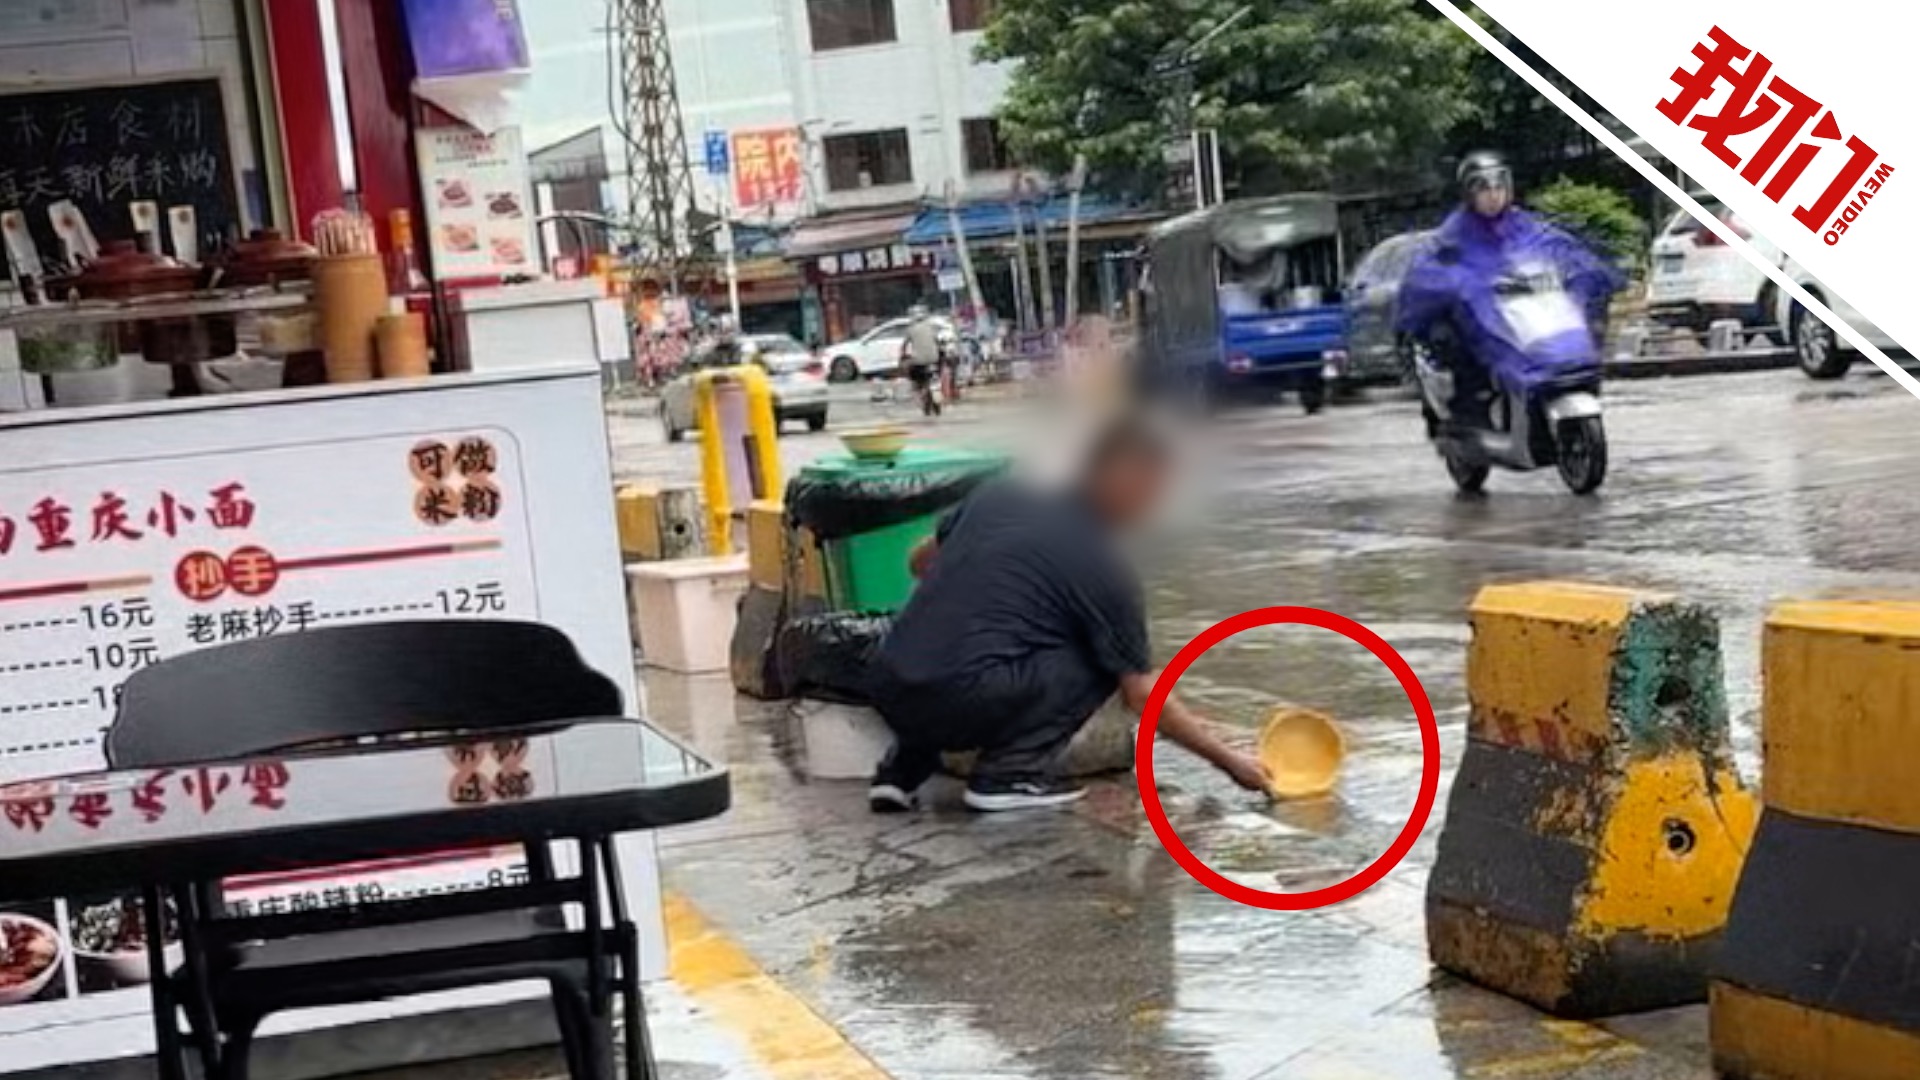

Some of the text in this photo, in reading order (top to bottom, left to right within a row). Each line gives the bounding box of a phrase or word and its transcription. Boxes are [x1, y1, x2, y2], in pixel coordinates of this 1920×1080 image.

[410, 437, 497, 480] 可做
[419, 483, 501, 525] 米粉
[181, 550, 274, 599] 抄手
[80, 597, 155, 630] 16元
[436, 581, 506, 615] 12元
[185, 600, 318, 644] 老麻抄手
[86, 636, 164, 671] 10元
